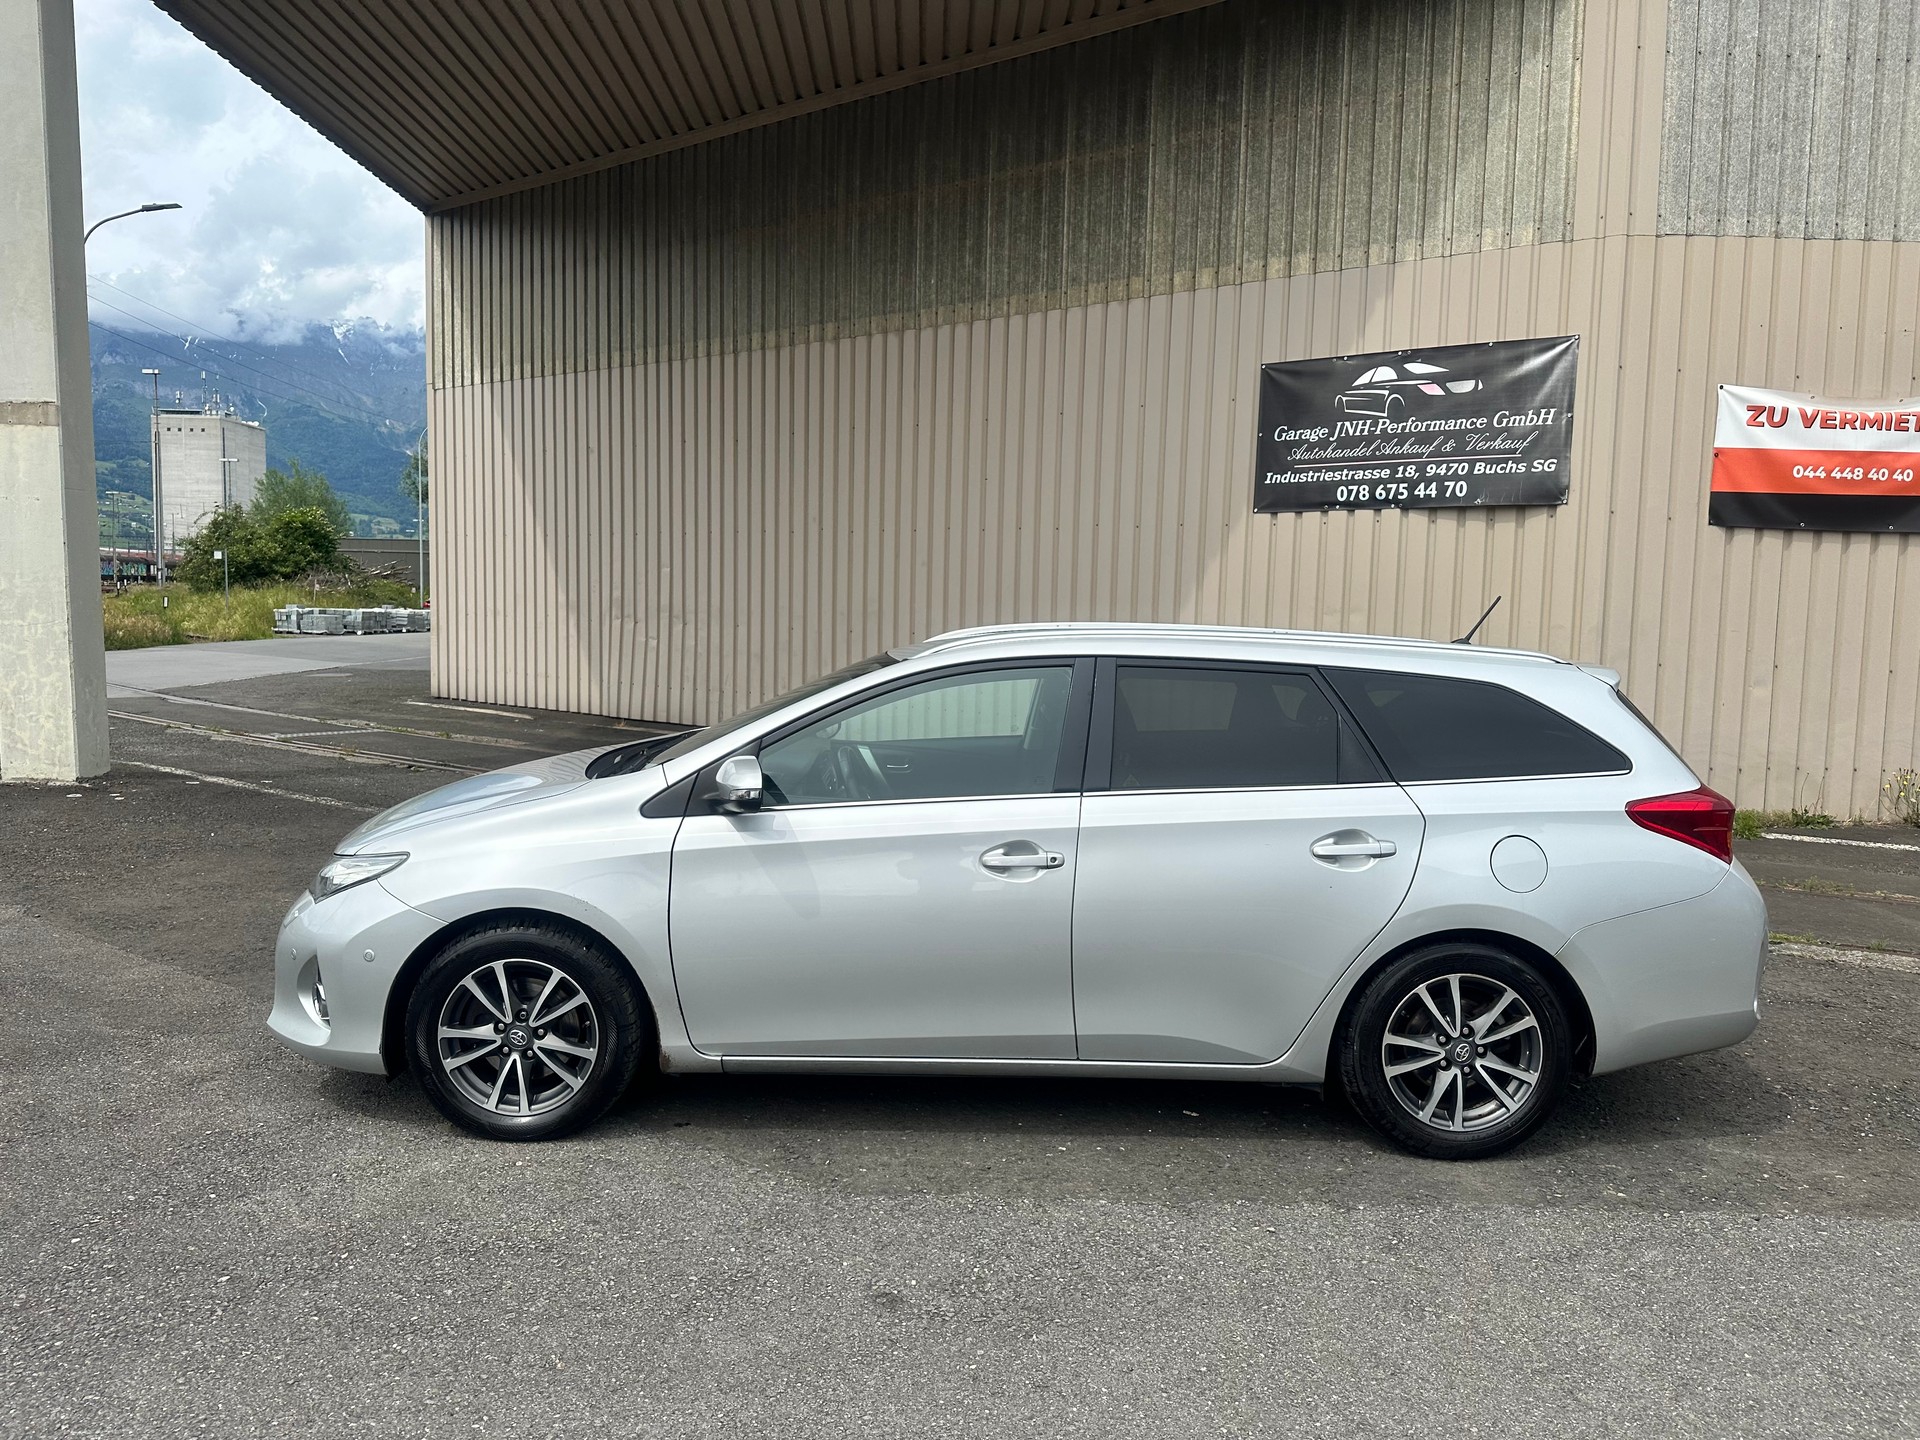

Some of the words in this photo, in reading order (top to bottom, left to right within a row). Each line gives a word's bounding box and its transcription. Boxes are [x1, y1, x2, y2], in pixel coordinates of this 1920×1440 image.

[1274, 426, 1329, 442] Garage
[1329, 417, 1487, 441] JNH-Performance
[1493, 408, 1557, 427] GmbH
[1746, 405, 1789, 428] ZU
[1287, 439, 1381, 461] Autohandel
[1376, 436, 1444, 459] Ankauf
[1441, 439, 1456, 452] &
[1465, 431, 1539, 454] Verkauf
[1264, 468, 1390, 484] Industriestrasse
[1395, 465, 1420, 479] 18,
[1425, 462, 1469, 477] 9470
[1473, 460, 1527, 475] Buchs
[1531, 459, 1558, 472] SG
[1792, 465, 1827, 479] 044
[1830, 466, 1863, 480] 448
[1867, 468, 1889, 481] 40
[1892, 469, 1914, 482] 40
[1336, 484, 1370, 502] 078
[1375, 483, 1408, 500] 675
[1414, 482, 1437, 498] 44
[1444, 480, 1468, 498] 70
